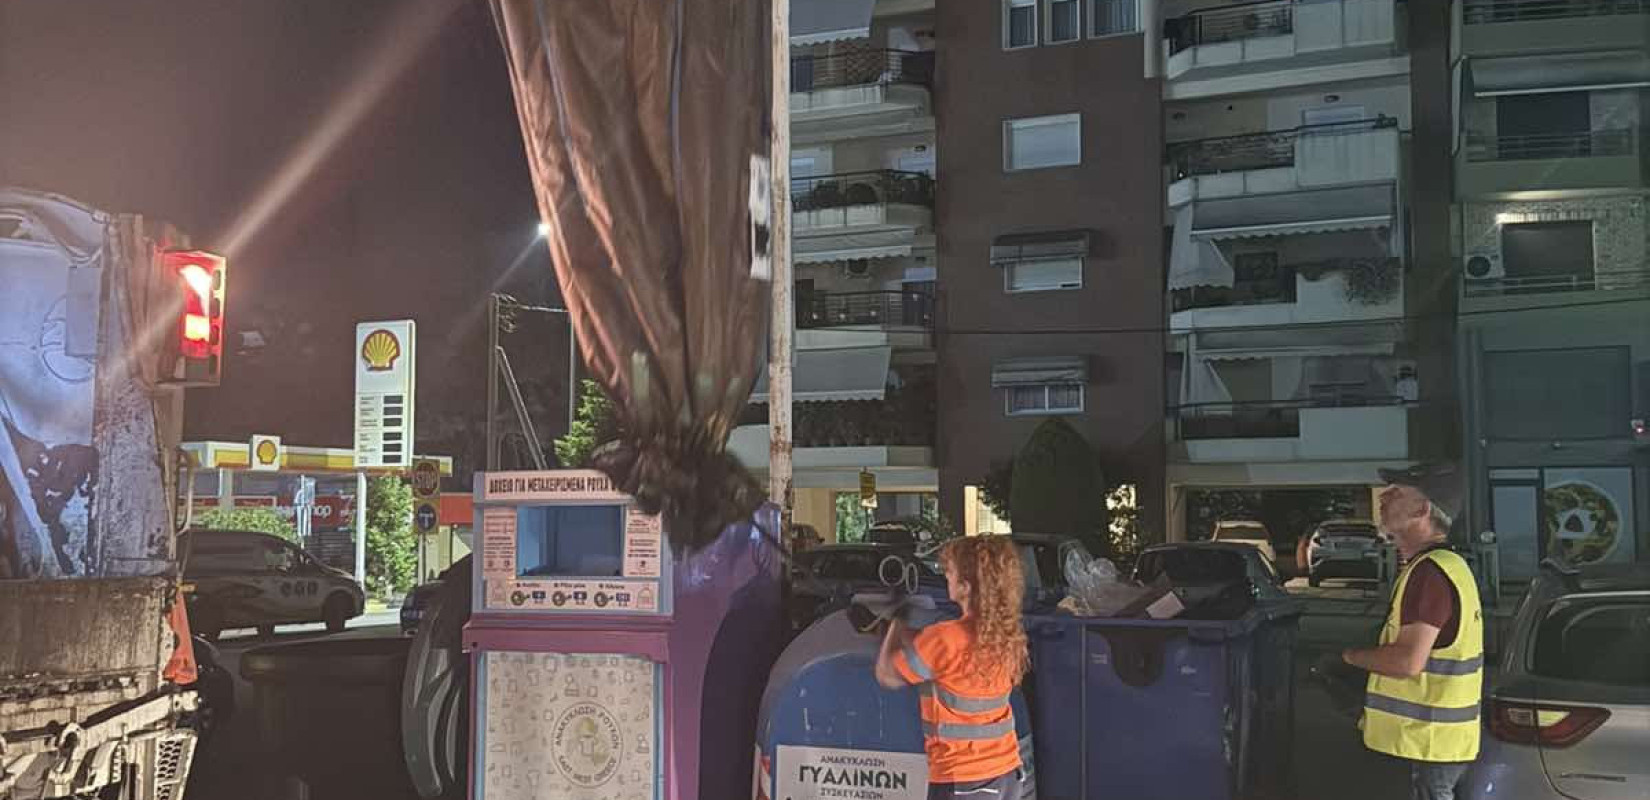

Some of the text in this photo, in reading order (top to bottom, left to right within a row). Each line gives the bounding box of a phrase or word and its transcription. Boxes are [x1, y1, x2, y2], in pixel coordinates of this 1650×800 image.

[820, 755, 885, 768] ΑΝΑΚΥΚΛΩΣΗ
[799, 765, 907, 790] ΓΥΑΛΙΝΩΝ
[820, 788, 883, 800] ΣΥΣΚΕΥΑΣΙΩΝ
